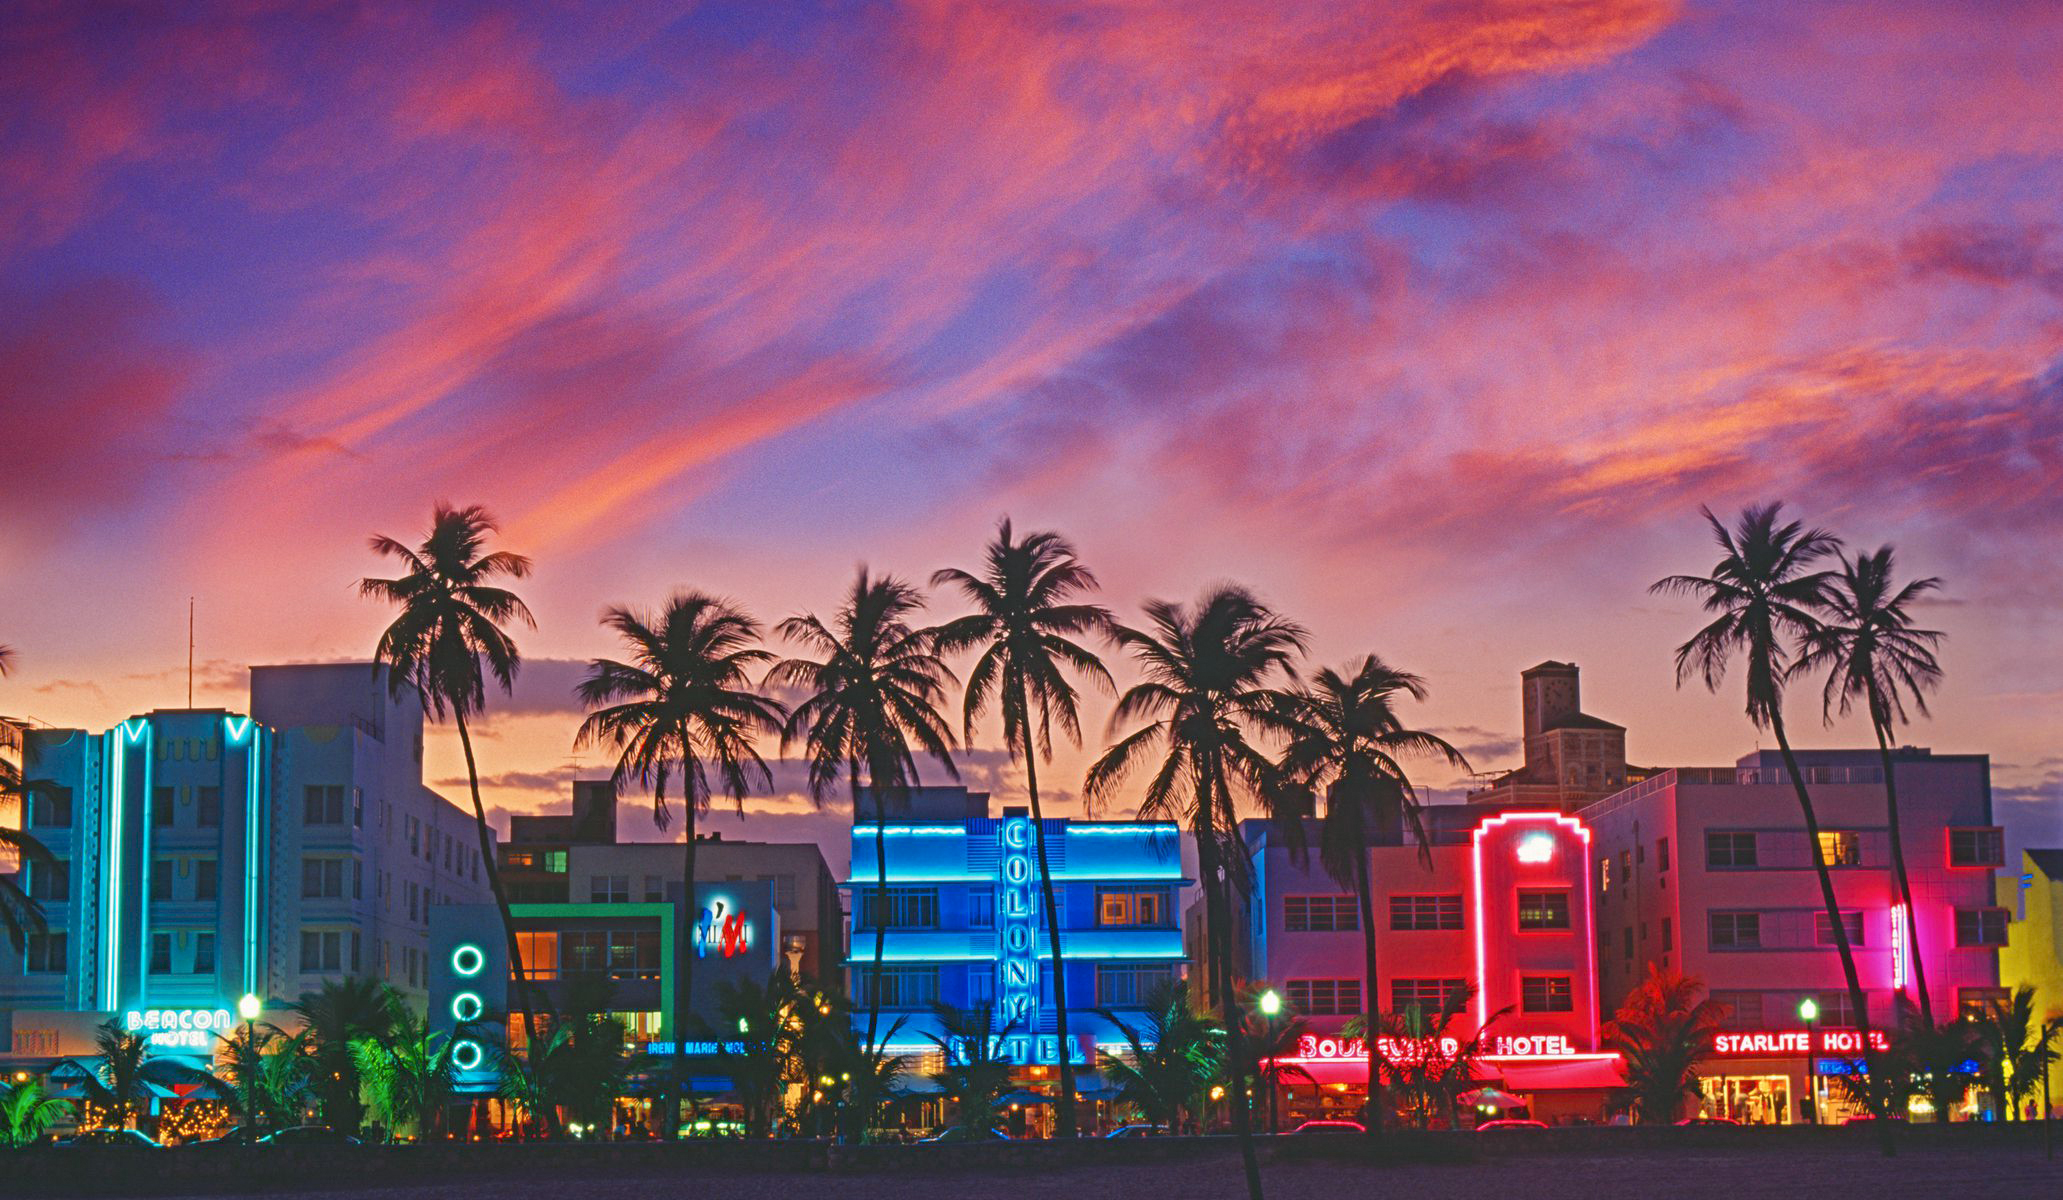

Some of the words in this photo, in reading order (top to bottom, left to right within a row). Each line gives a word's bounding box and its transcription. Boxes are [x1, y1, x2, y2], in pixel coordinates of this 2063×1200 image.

[1006, 820, 1029, 1024] COLONY
[127, 1010, 231, 1030] BEACON
[151, 1031, 208, 1046] HOTEL
[685, 1042, 718, 1054] MARIE
[1497, 1036, 1575, 1055] HOTEL
[1715, 1033, 1809, 1052] STARLITE
